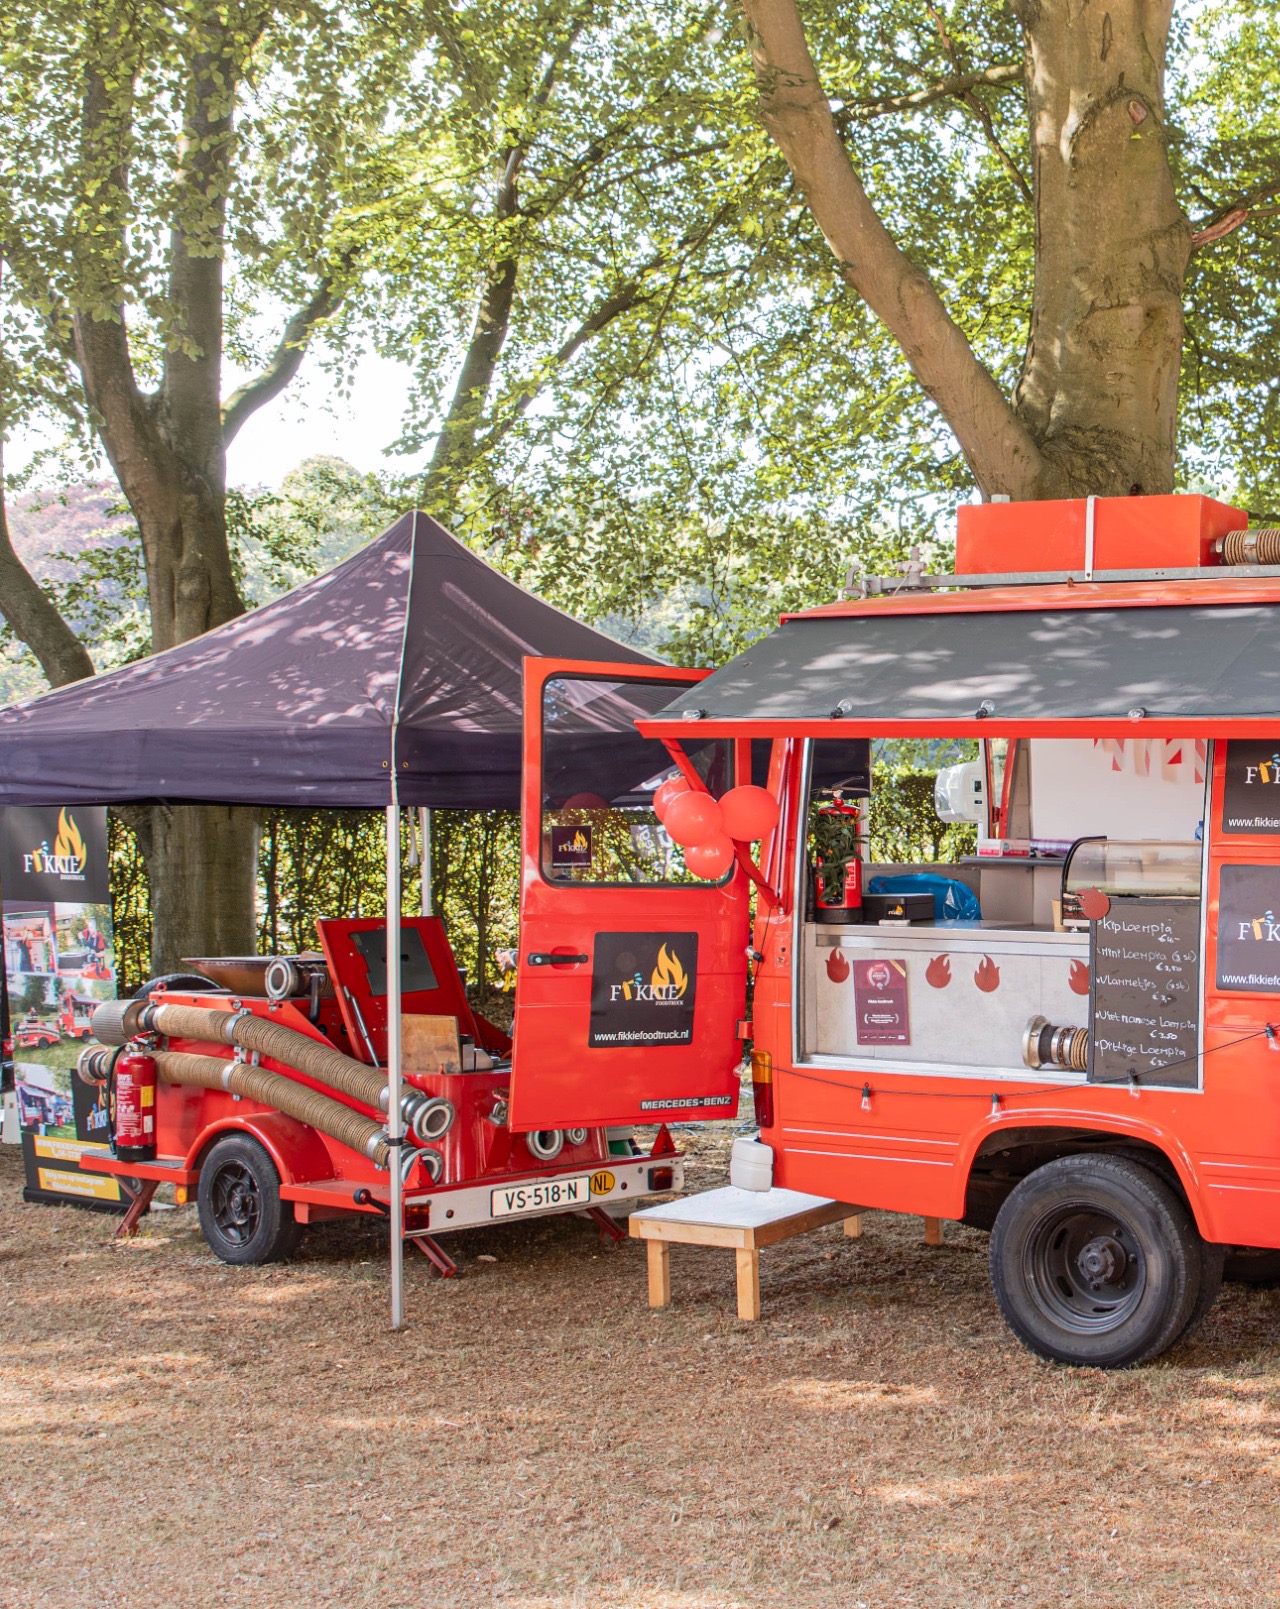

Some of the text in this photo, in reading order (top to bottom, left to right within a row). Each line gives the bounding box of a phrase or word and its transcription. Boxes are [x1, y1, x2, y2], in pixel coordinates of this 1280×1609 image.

[610, 980, 681, 1002] FIKKIE
[594, 1030, 689, 1042] www.fikkiefoodtruck.nl
[640, 1096, 732, 1110] MERCEDES-BENZ
[505, 1175, 611, 1211] VS-518-N NL
